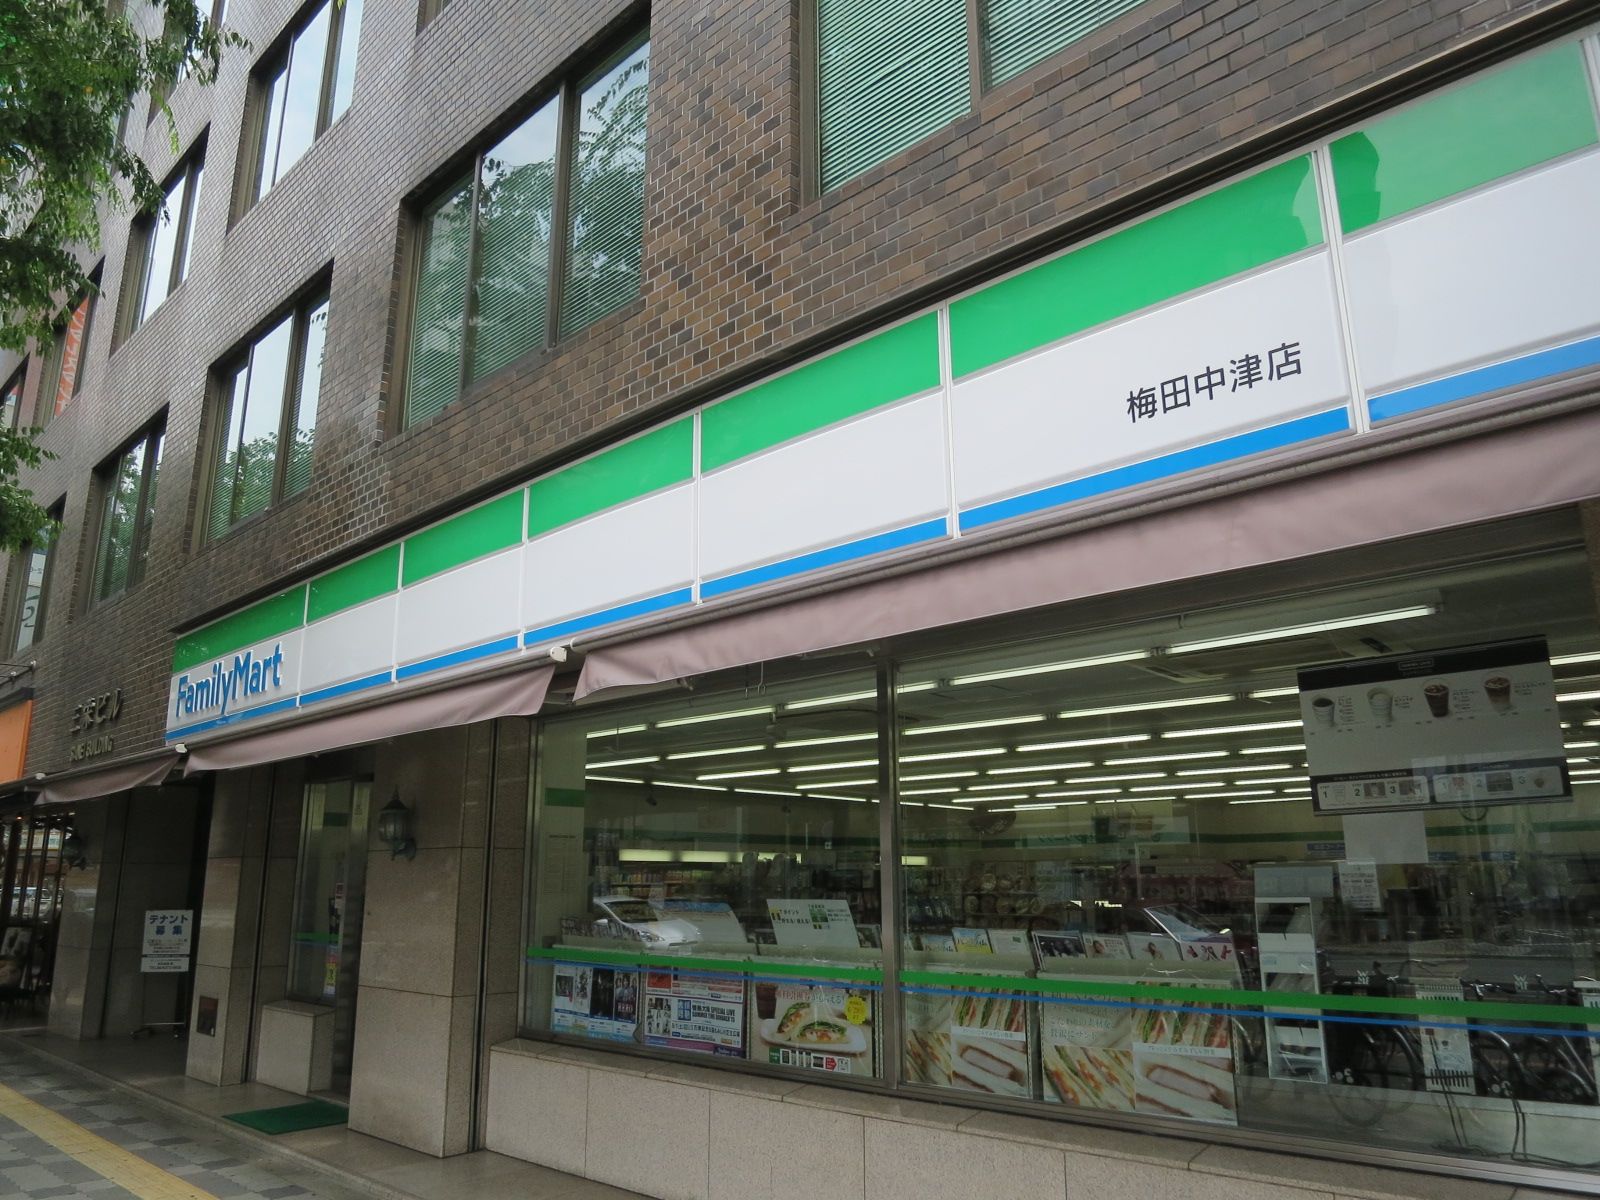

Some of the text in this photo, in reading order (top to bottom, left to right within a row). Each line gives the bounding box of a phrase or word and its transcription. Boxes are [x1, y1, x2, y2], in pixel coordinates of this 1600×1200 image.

[1126, 342, 1302, 423] 梅田中津店
[176, 641, 283, 717] FamilyMart
[1322, 790, 1328, 799] 1
[1353, 788, 1361, 797] 2
[1389, 785, 1397, 794] 3
[150, 914, 188, 925] テナント
[155, 925, 183, 936] 募集
